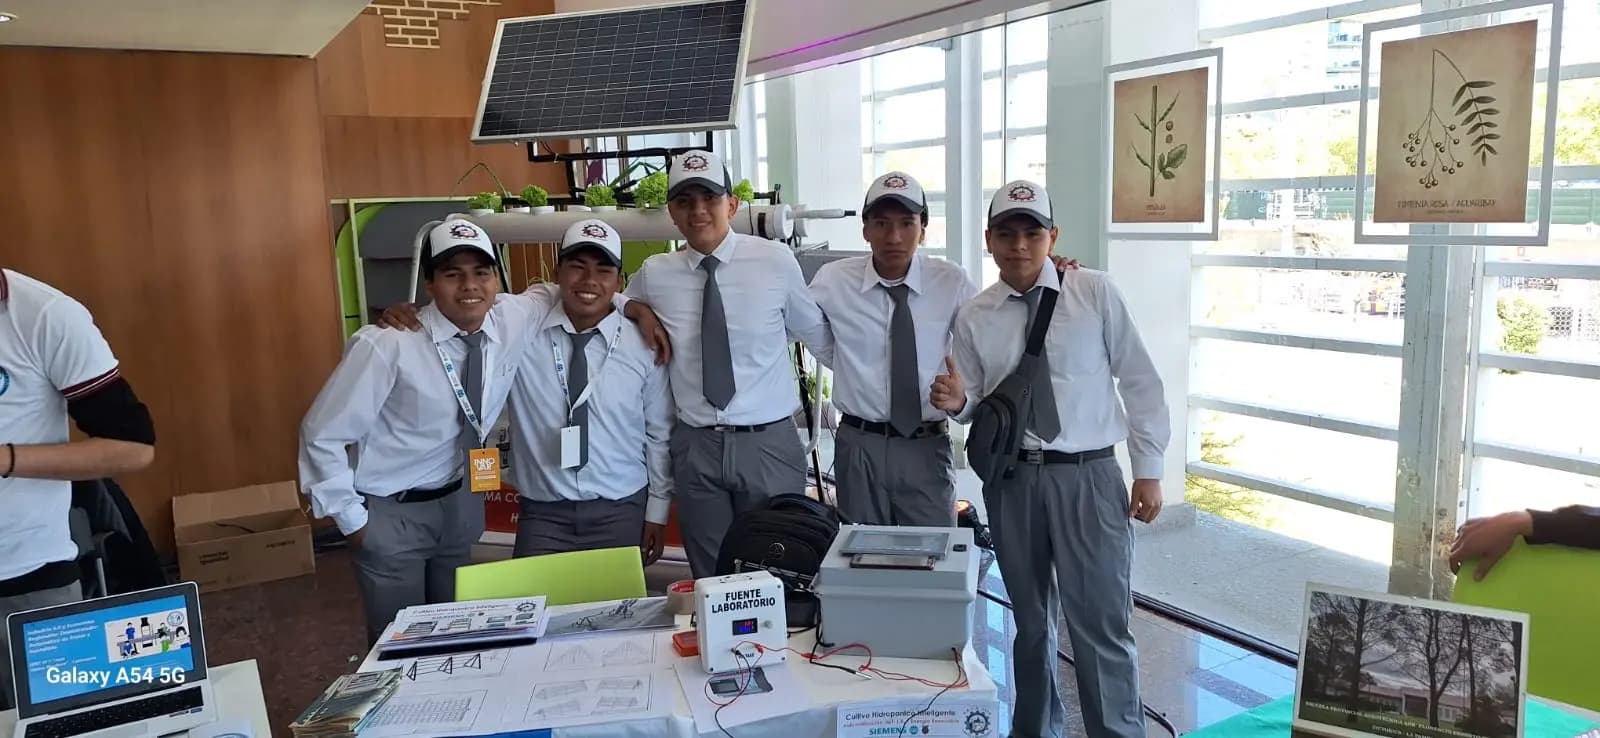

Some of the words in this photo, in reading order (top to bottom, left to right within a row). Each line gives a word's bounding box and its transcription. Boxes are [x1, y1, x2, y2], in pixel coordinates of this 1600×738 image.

[725, 588, 762, 602] FUENTE
[711, 597, 776, 614] LABORATORIO
[845, 713, 870, 722] Cultivo
[869, 726, 907, 736] SIEMENS
